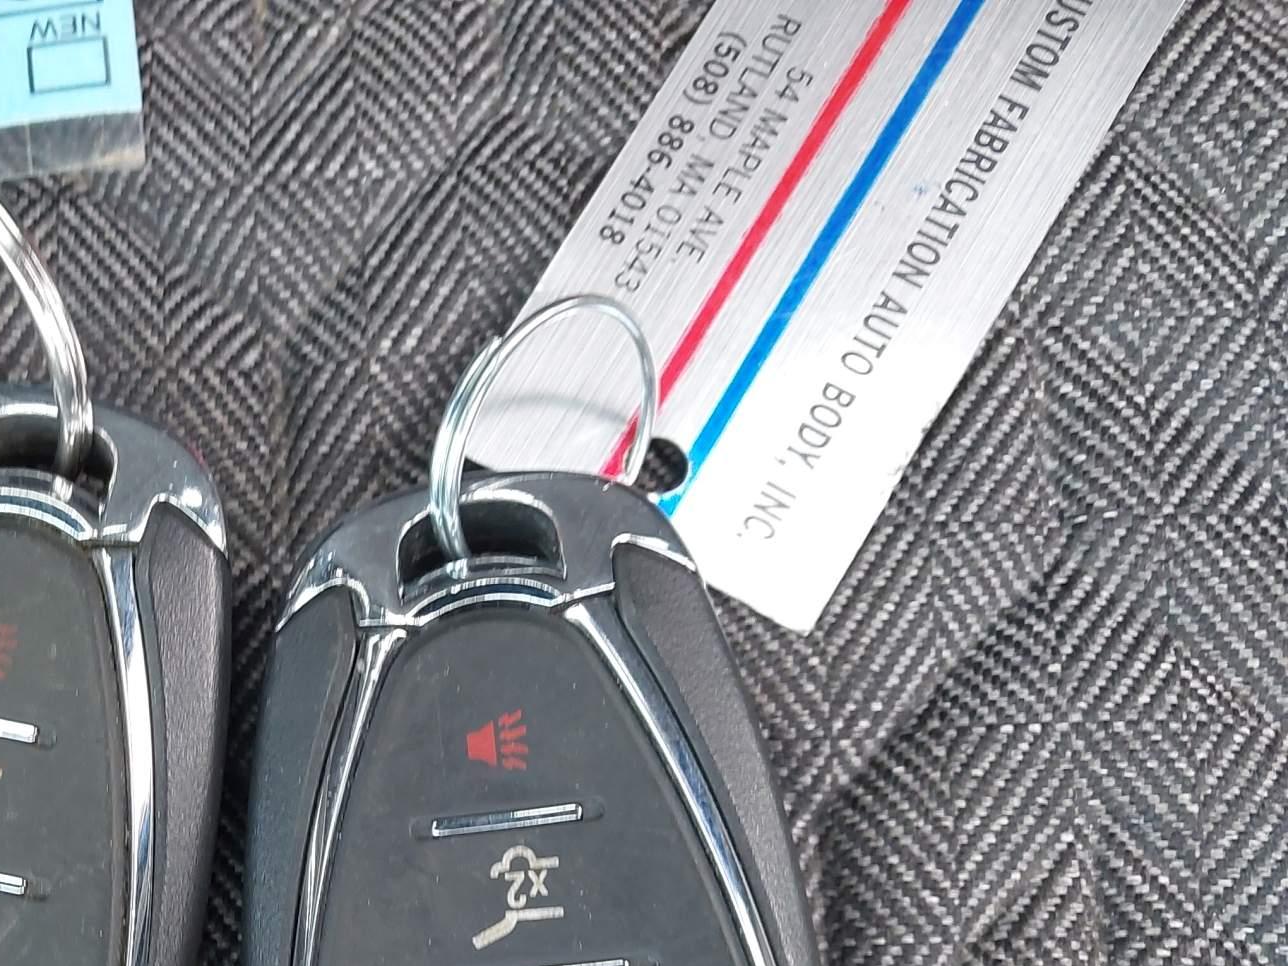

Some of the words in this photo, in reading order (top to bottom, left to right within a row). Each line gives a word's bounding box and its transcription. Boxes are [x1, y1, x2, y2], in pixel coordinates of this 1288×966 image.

[30, 11, 102, 41] NEW
[682, 32, 748, 105] (508)
[697, 14, 802, 142] RUTLAND,
[775, 66, 814, 103] 54
[599, 115, 695, 246] 886-4018
[668, 153, 715, 196] MA
[712, 107, 789, 204] MAPLE
[891, 94, 1031, 289] FABRICATION
[614, 204, 683, 293] 01543
[840, 291, 909, 376] AUTO
[736, 481, 797, 540] INC.
